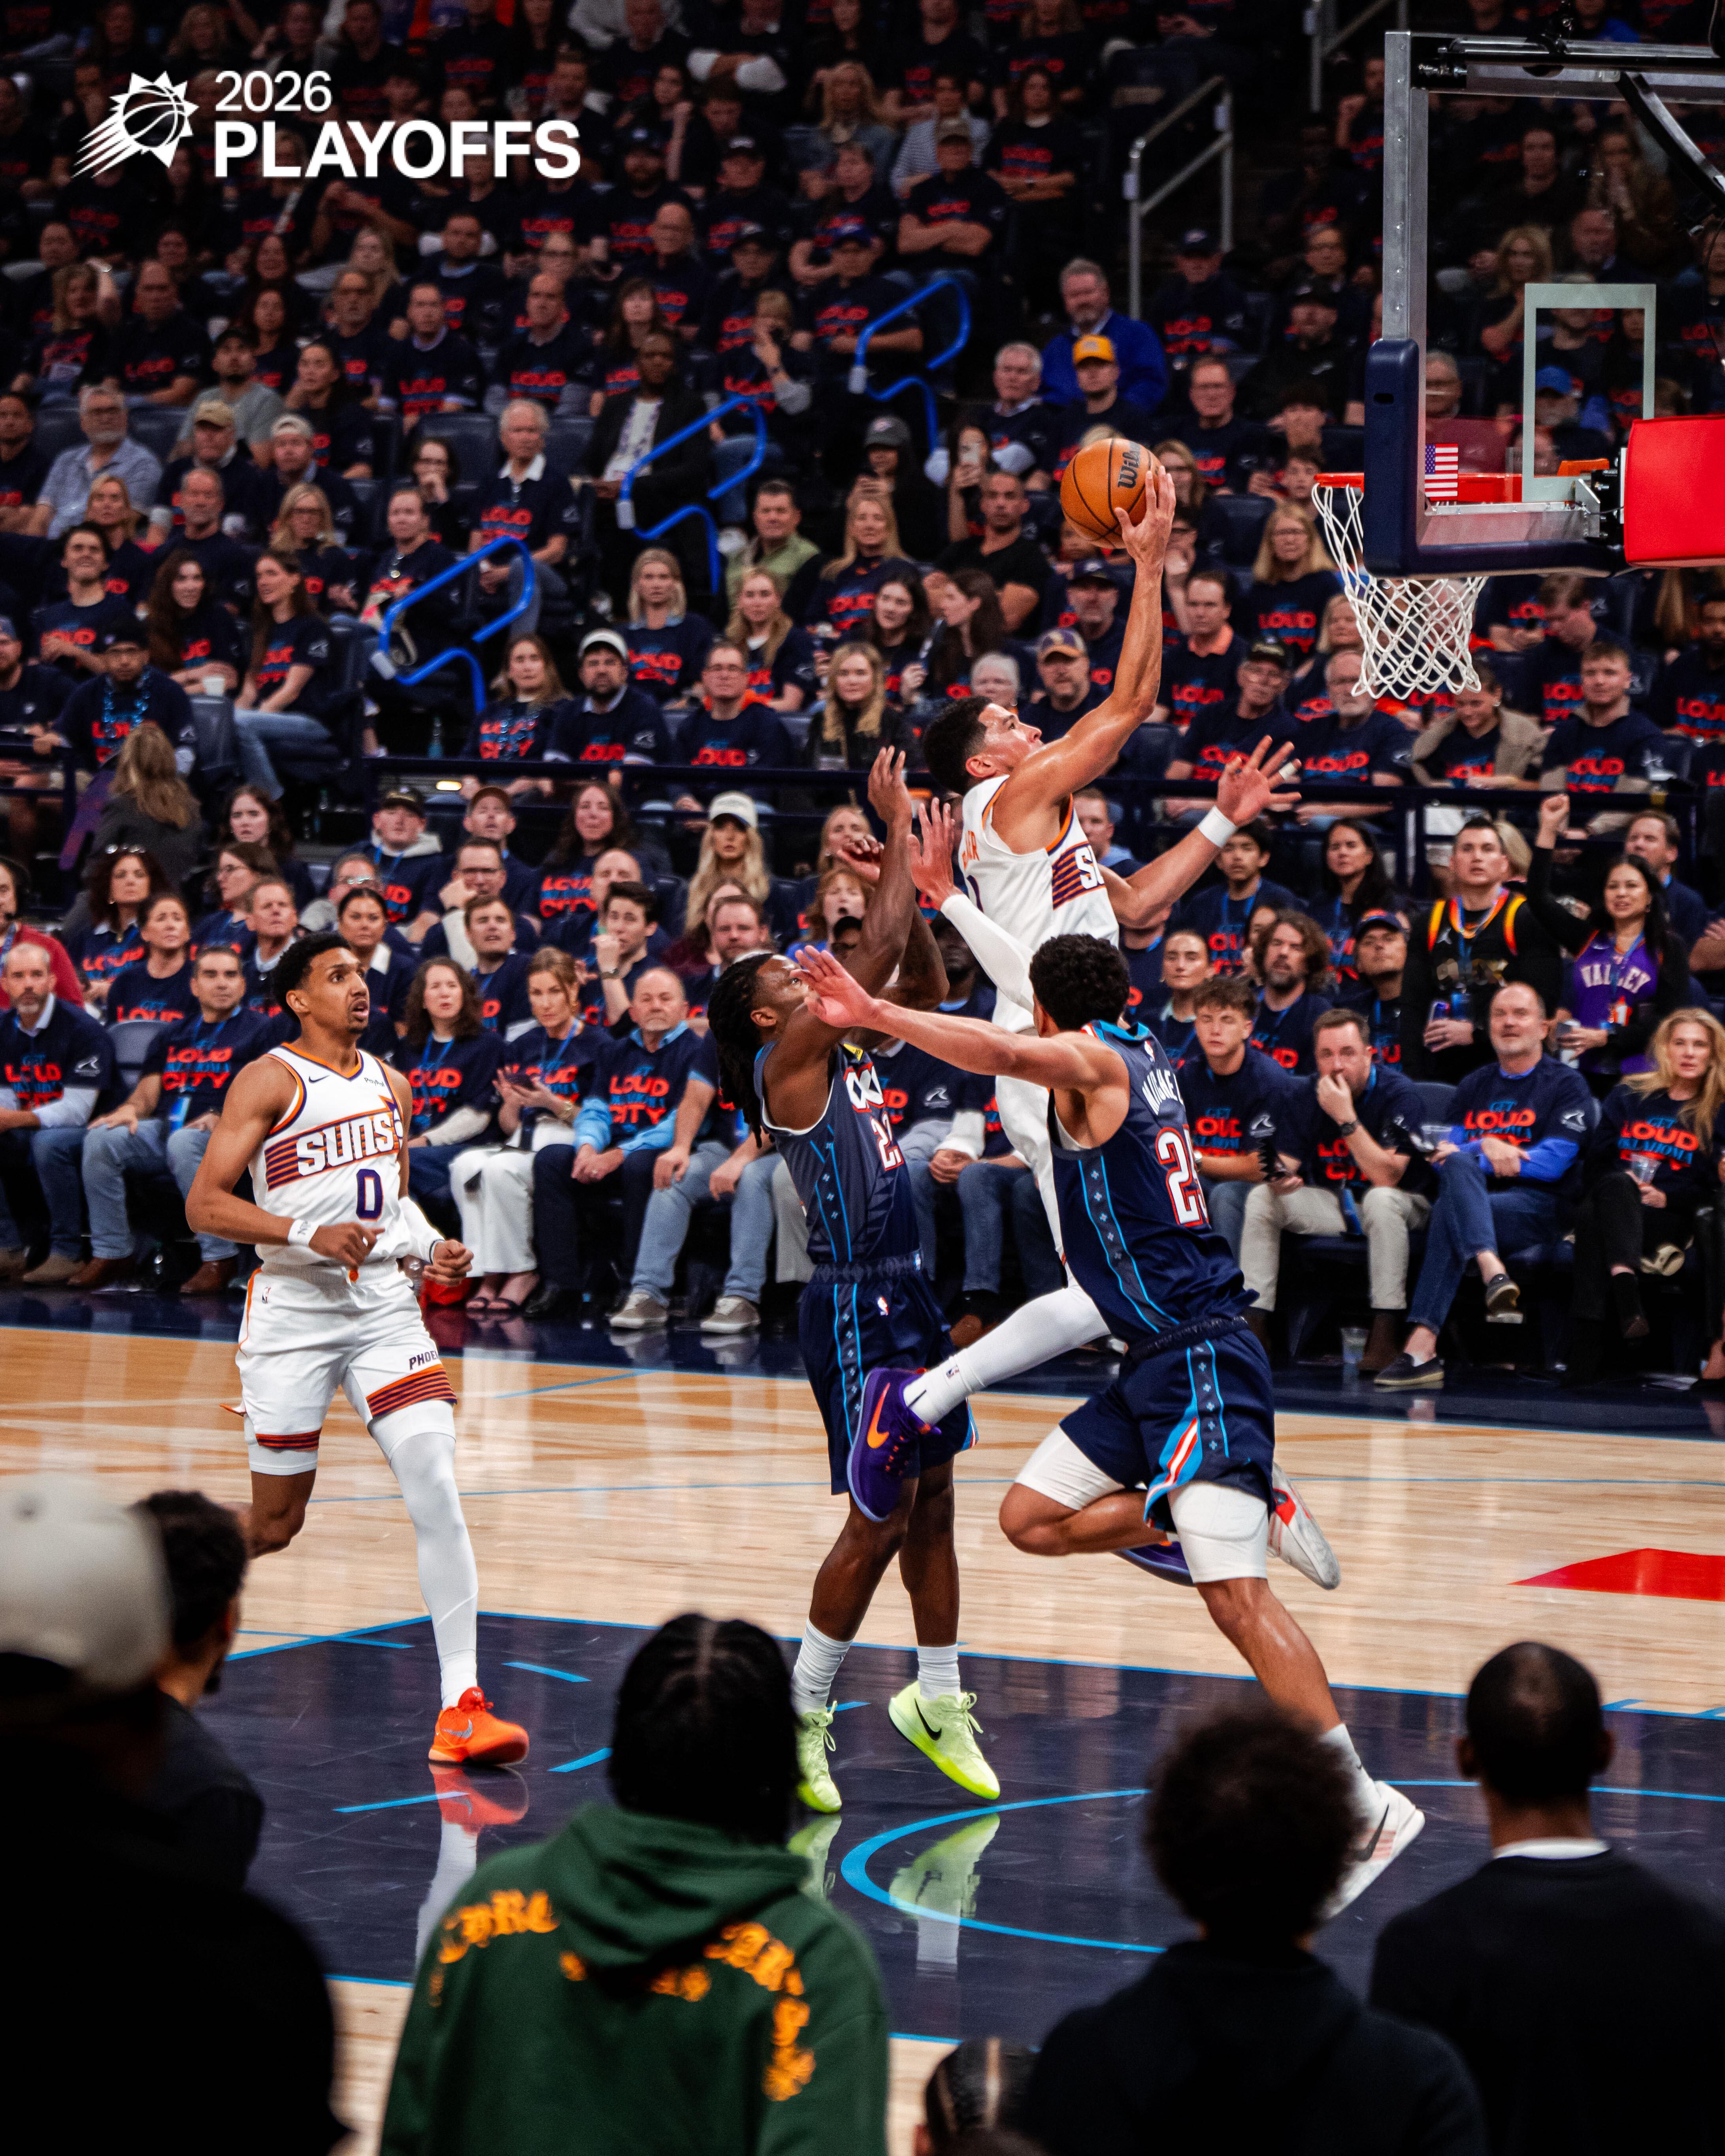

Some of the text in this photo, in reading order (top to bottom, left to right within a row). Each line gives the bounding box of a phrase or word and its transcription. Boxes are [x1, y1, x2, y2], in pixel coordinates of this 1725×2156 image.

[1580, 963, 1651, 994] VALEY
[166, 1046, 233, 1063] LOUD
[161, 1071, 230, 1091] CITY
[364, 1077, 385, 1087] PayPal
[609, 1075, 670, 1097] LOUD
[1463, 1108, 1536, 1130] LOUD
[296, 1113, 394, 1176] SUNS
[1621, 1121, 1700, 1152] LOUD
[356, 1168, 384, 1221] 0
